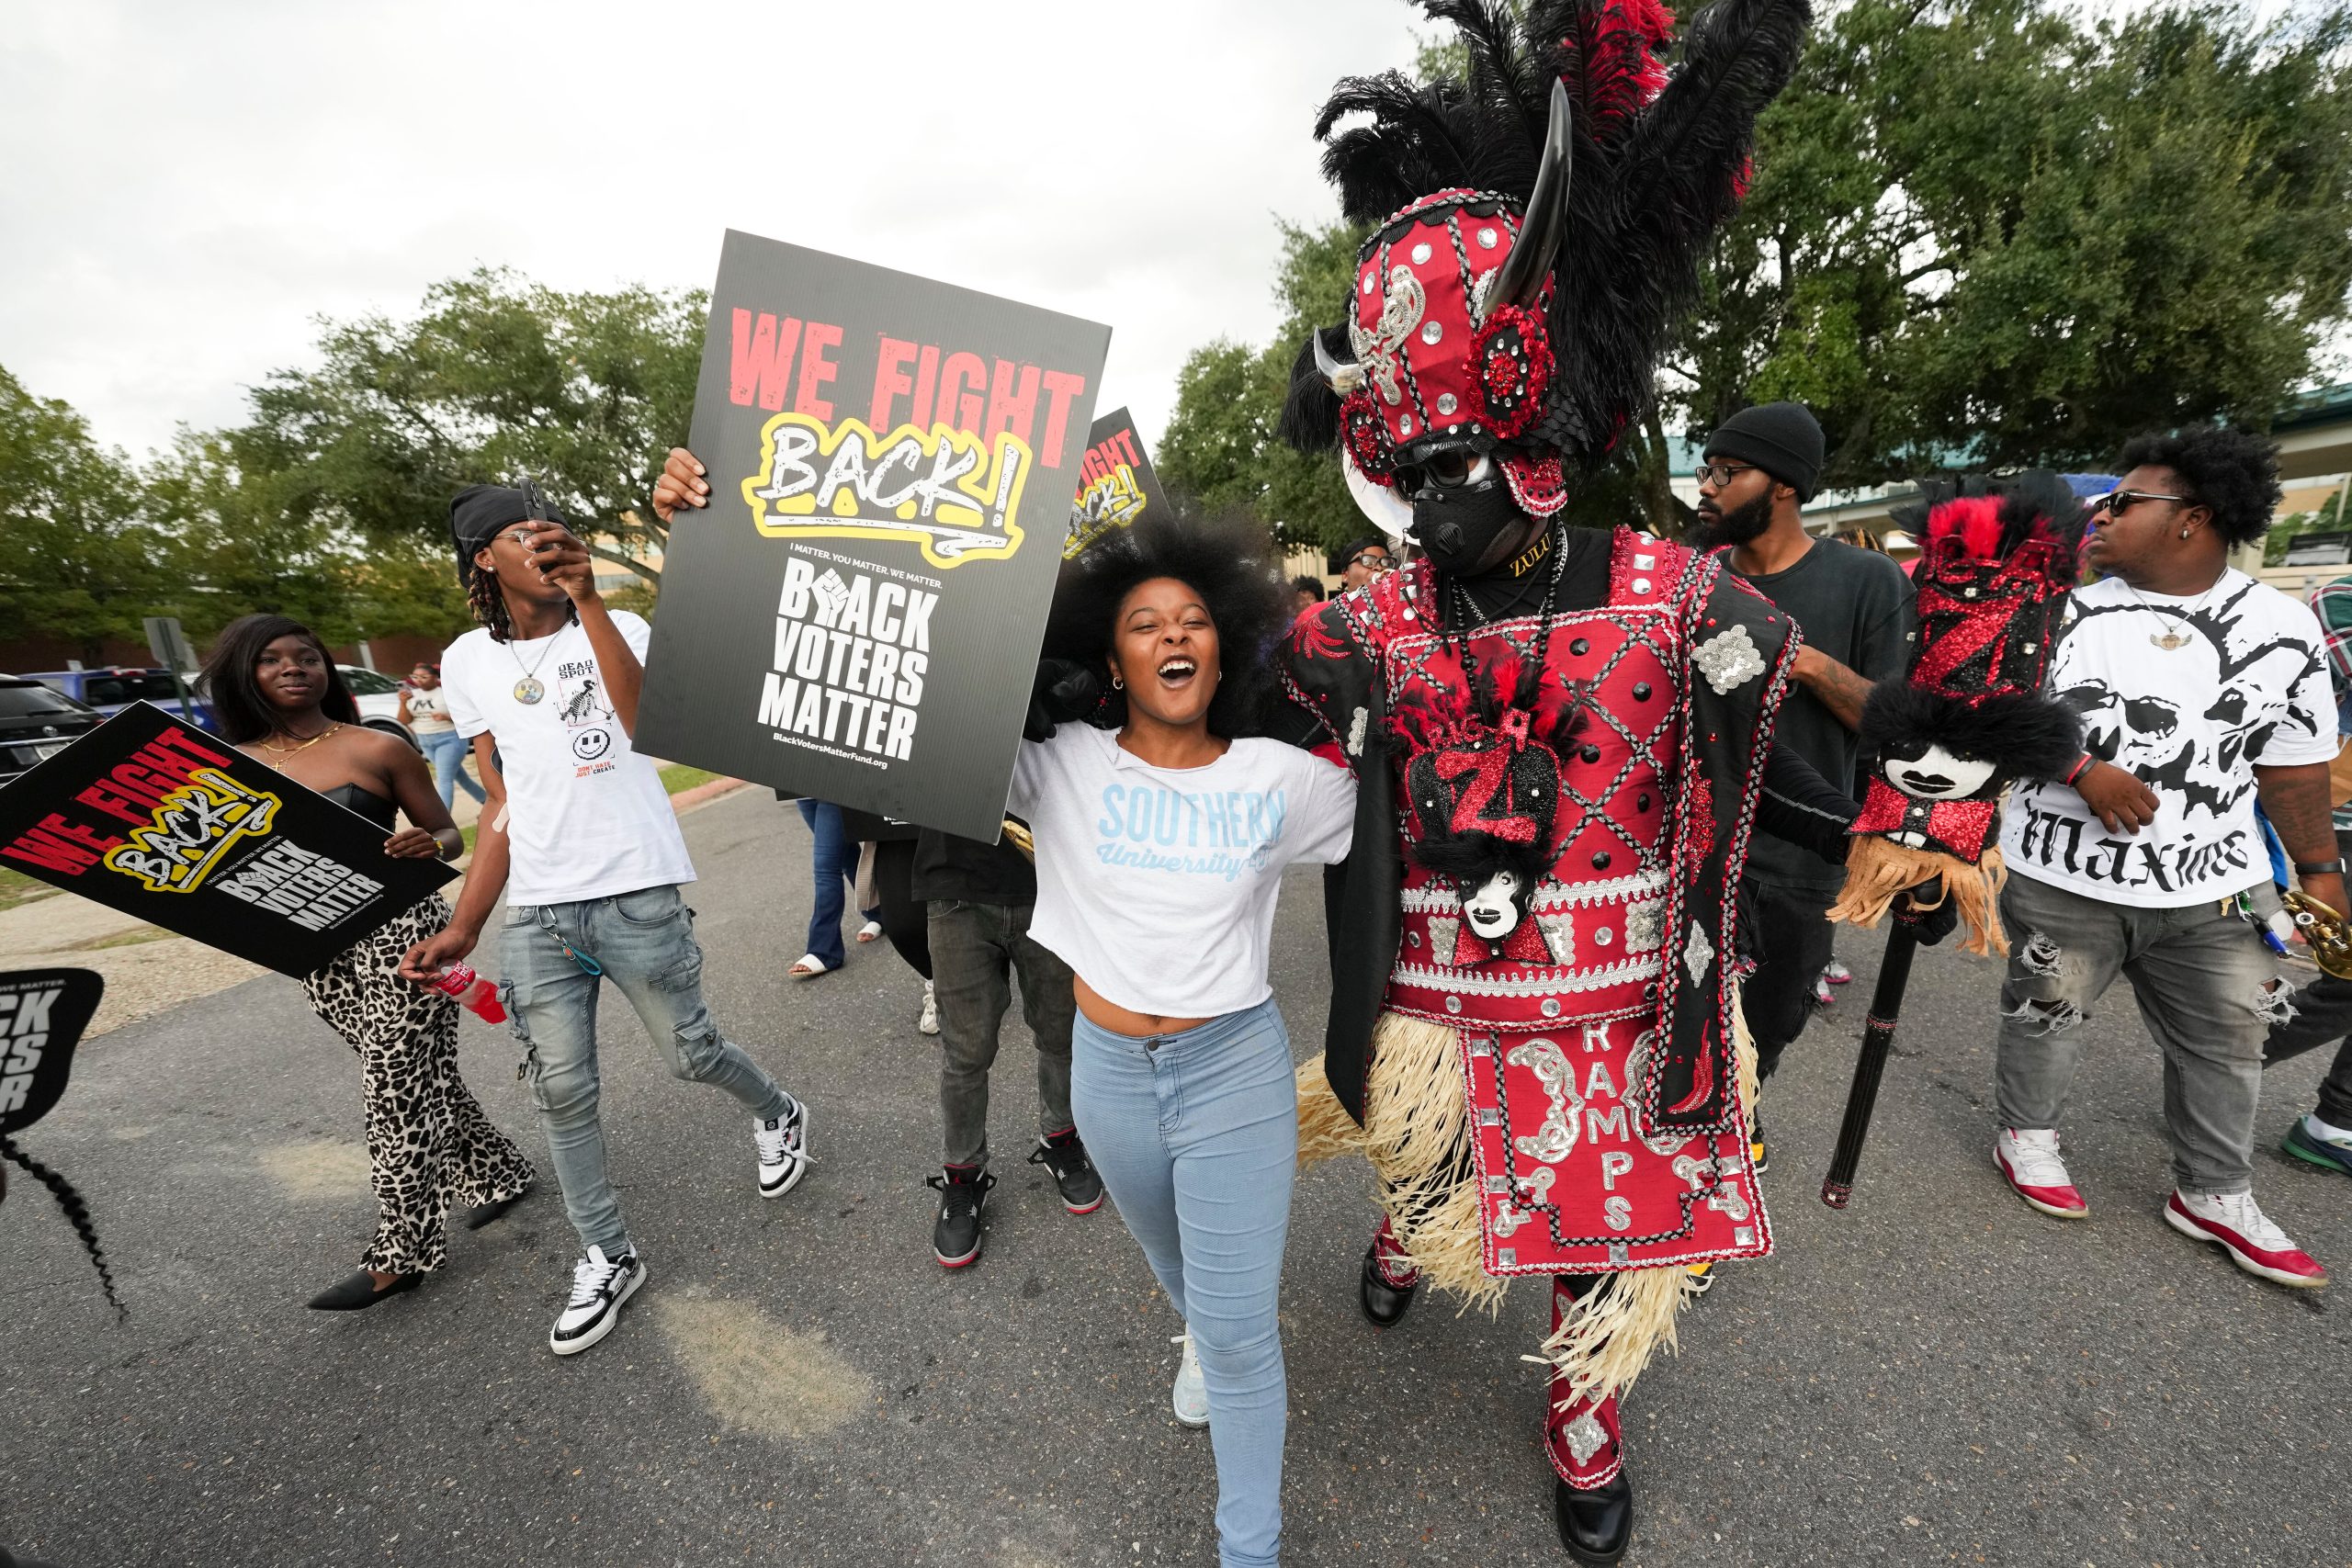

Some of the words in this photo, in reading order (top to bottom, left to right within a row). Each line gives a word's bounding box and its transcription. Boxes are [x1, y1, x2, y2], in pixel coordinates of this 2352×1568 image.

[729, 308, 843, 423] WE
[868, 337, 1085, 468] FIGHT
[757, 425, 1019, 527] BACK!
[1077, 428, 1140, 499] IGHT
[790, 542, 794, 550] I
[795, 543, 831, 560] MATTER.
[832, 553, 851, 565] YOU
[853, 558, 889, 575] MATTER.
[890, 568, 905, 579] WE
[906, 572, 943, 589] MATTER.
[1510, 533, 1551, 578] ZULU
[778, 557, 939, 652] BACK
[559, 659, 594, 672] DEAD
[559, 666, 594, 680] SPOT
[774, 616, 929, 706] VOTERS
[757, 671, 917, 761] MATTER
[593, 764, 616, 774] CREATE
[595, 761, 611, 769] HATE
[773, 733, 888, 769] BlackVotersMatterFund.org
[0, 812, 126, 875] WE
[74, 726, 233, 827] FIGHT
[115, 772, 258, 886] BACK!
[1099, 784, 1287, 848] SOUTHERN
[214, 840, 322, 903] BACK
[226, 863, 239, 872] YOU
[253, 857, 354, 916] VOTERS
[1097, 841, 1244, 882] University
[288, 873, 385, 932] MATTER
